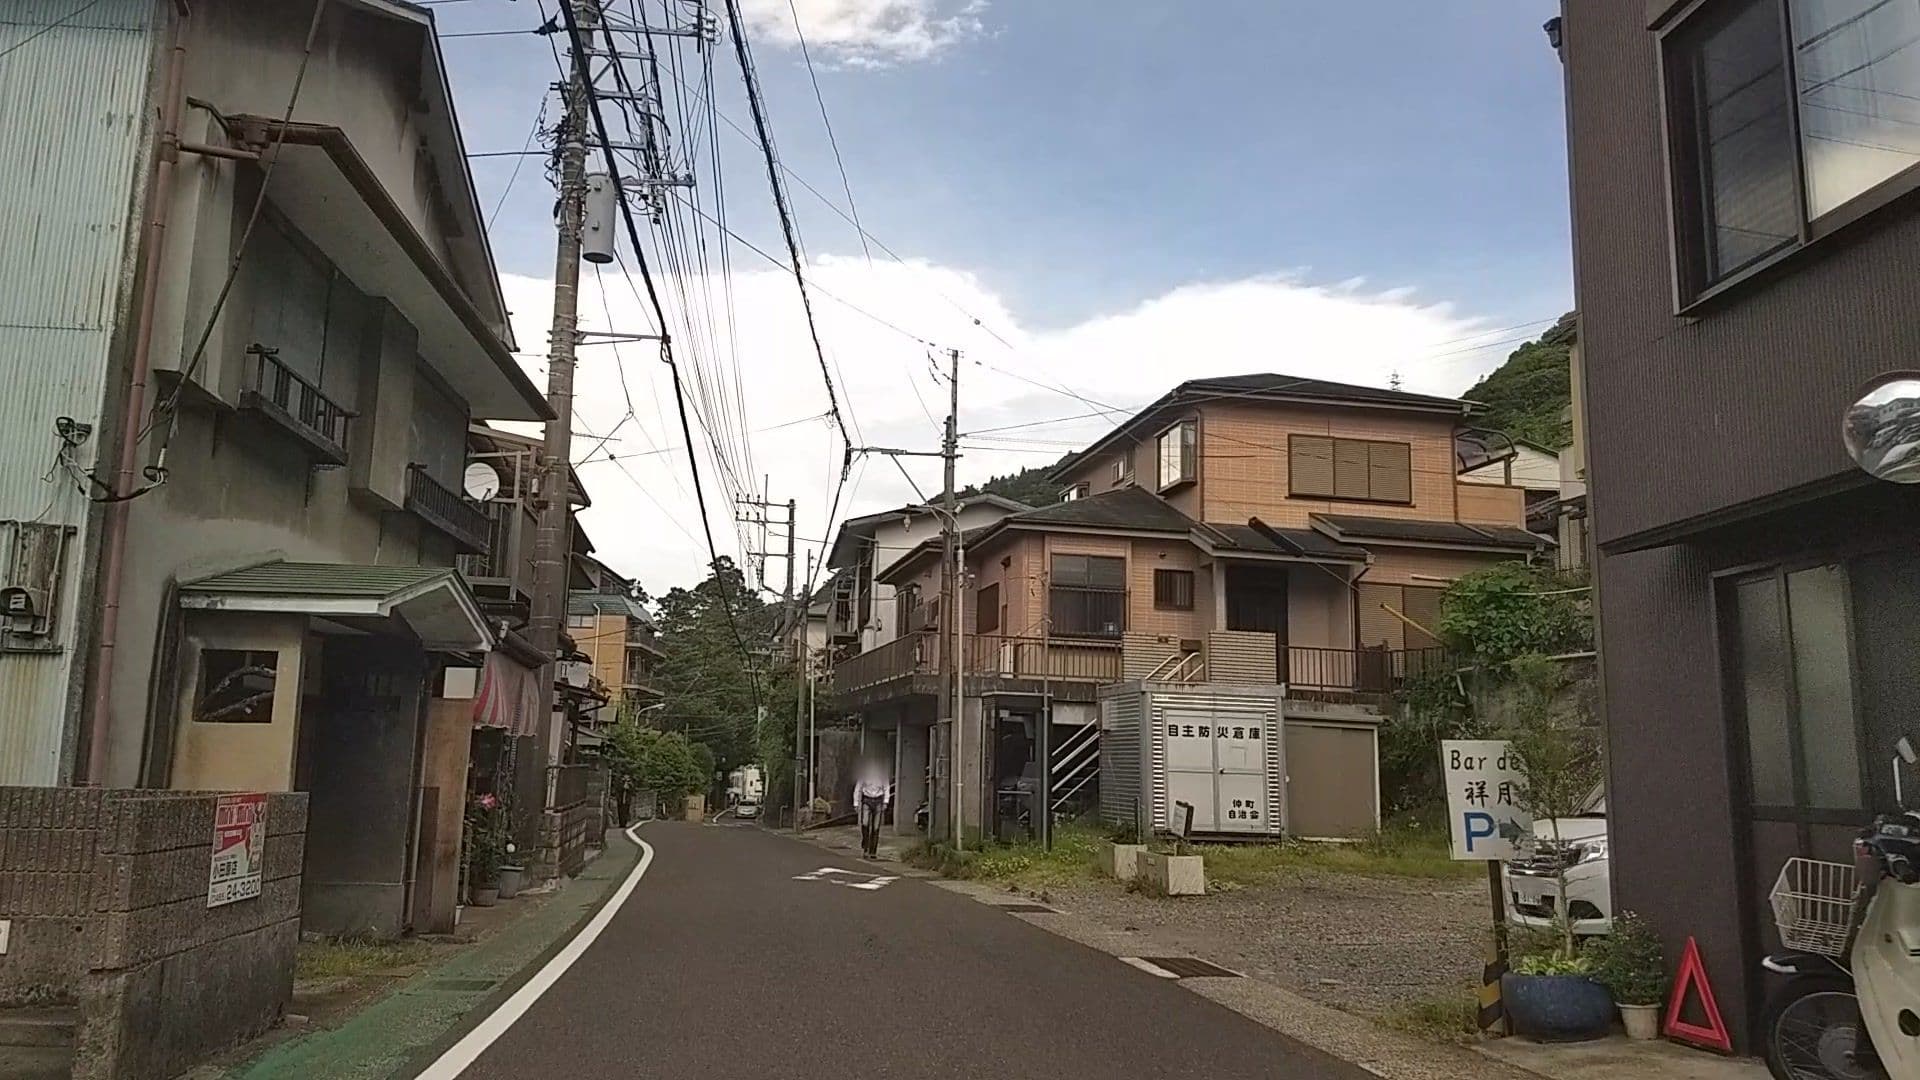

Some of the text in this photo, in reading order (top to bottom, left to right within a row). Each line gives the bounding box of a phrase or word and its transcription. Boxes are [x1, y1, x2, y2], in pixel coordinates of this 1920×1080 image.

[1168, 724, 1260, 739] 自主防災倉庫
[1450, 749, 1487, 770] Bar
[1232, 799, 1255, 808] 仲町
[1464, 780, 1512, 808] 祥月
[1228, 810, 1259, 819] 自治会
[1463, 812, 1495, 852] P
[226, 880, 260, 900] 24-3200
